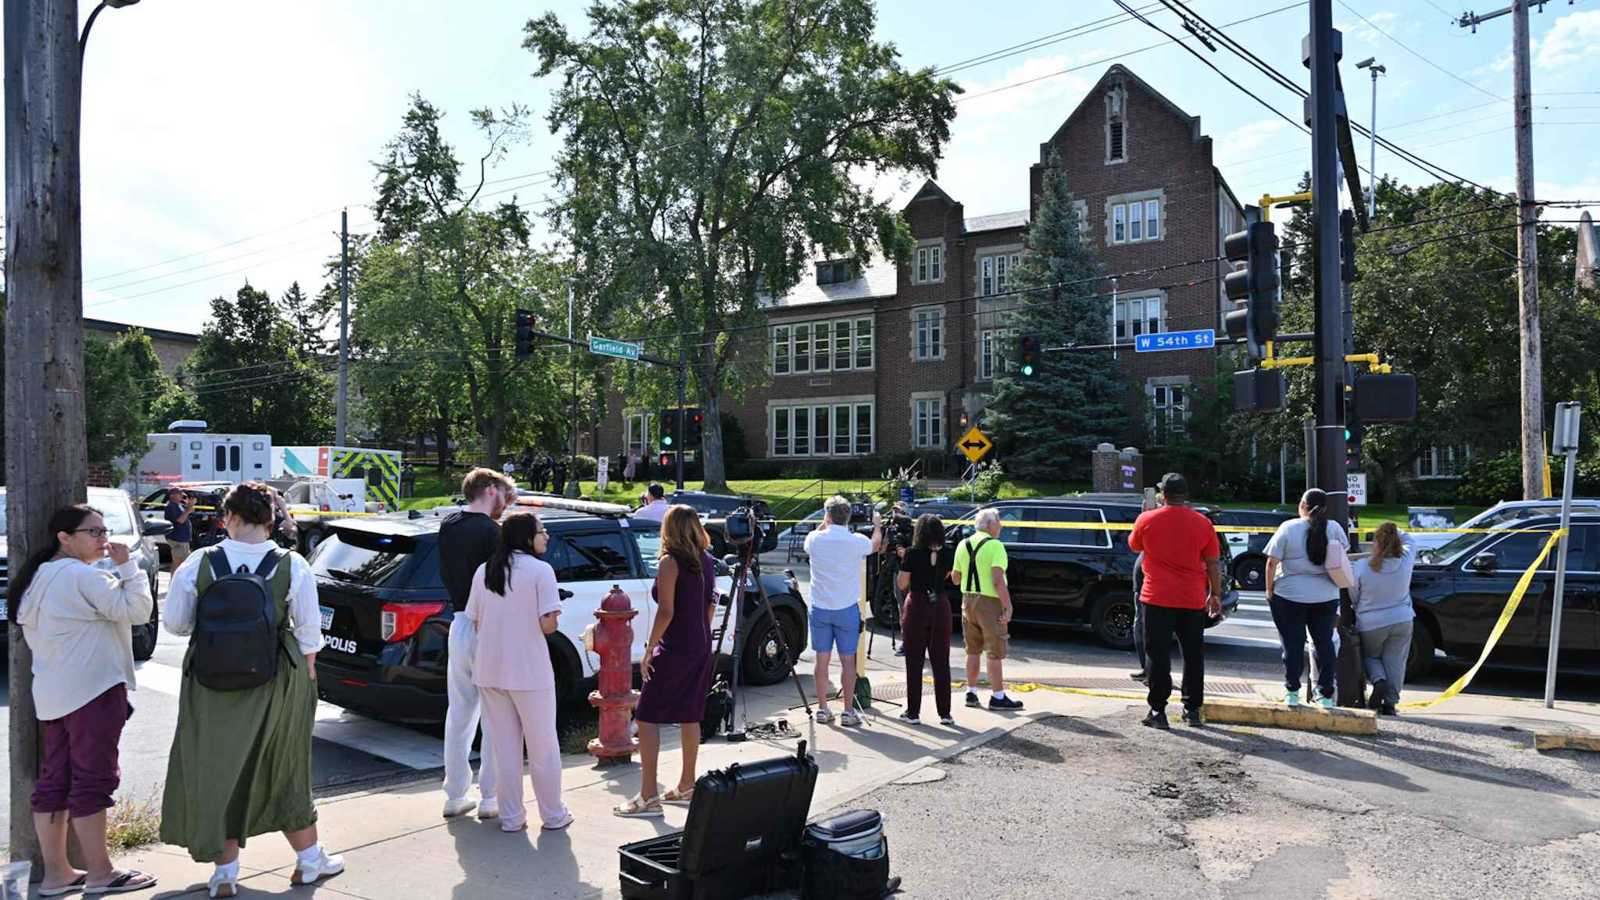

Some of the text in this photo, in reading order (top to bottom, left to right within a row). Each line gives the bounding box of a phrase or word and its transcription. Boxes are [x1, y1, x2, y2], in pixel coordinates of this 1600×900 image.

[592, 340, 623, 354] Garfield
[1141, 334, 1209, 348] W 54th St
[325, 634, 357, 654] POLIS
